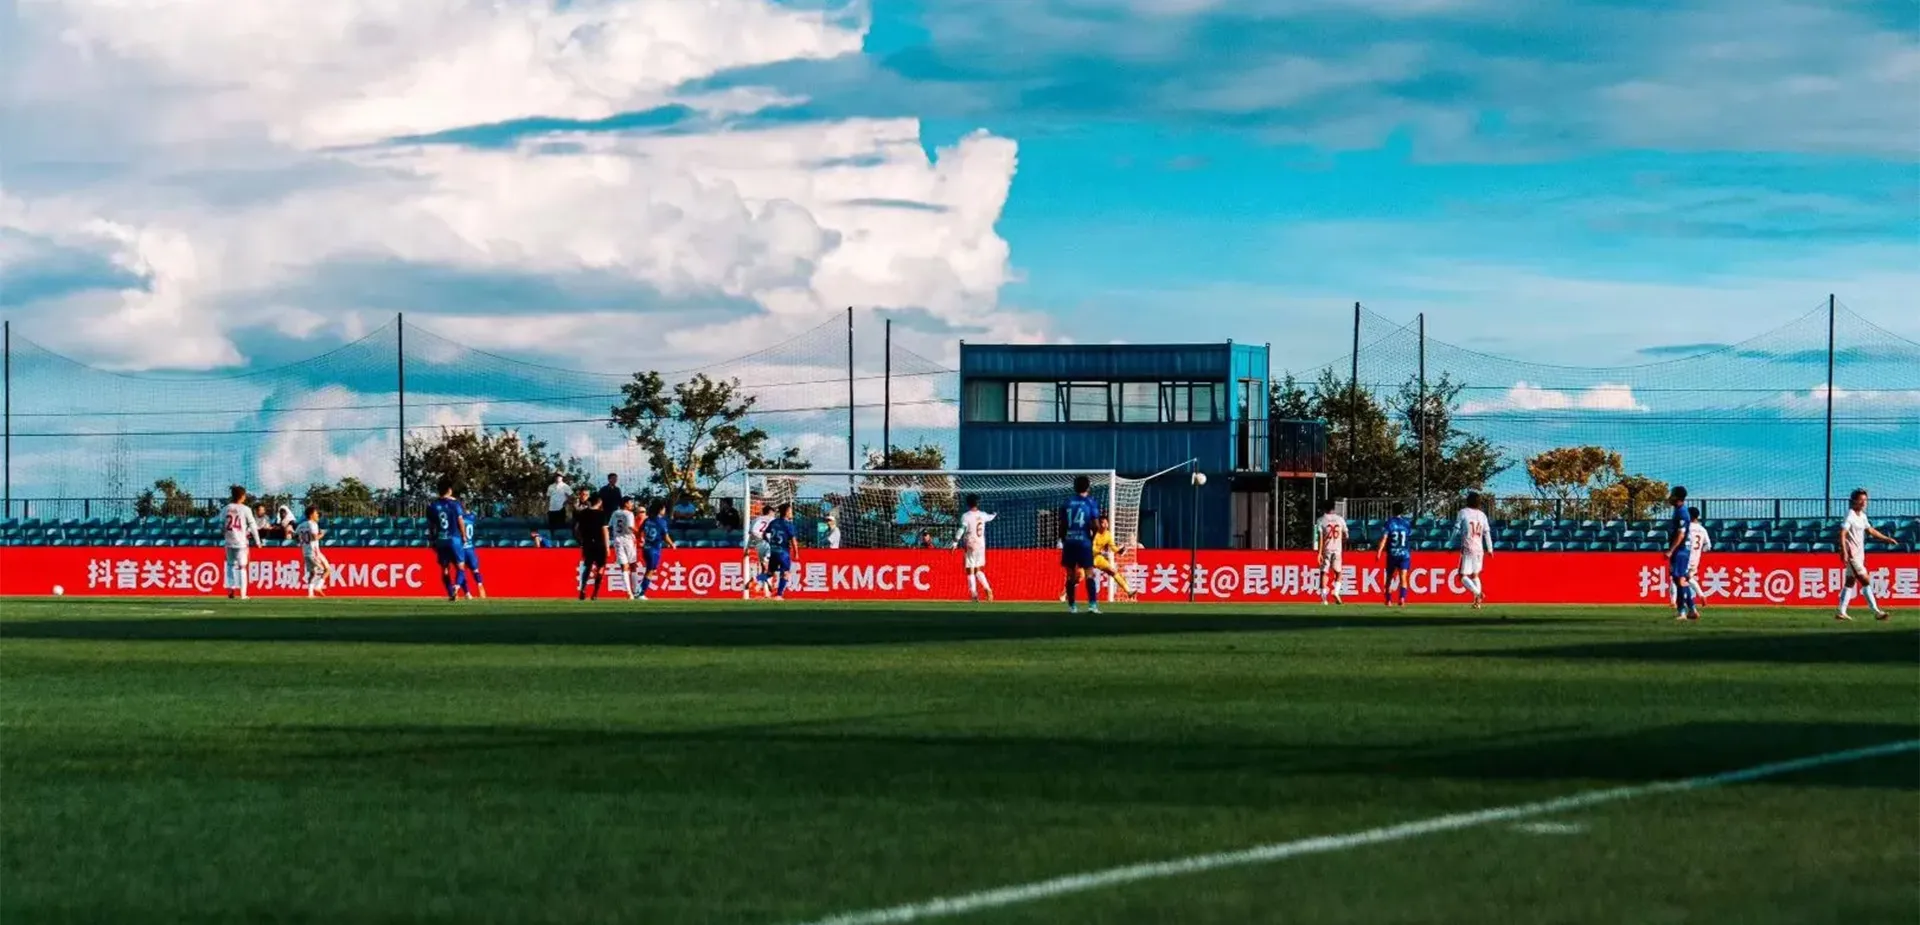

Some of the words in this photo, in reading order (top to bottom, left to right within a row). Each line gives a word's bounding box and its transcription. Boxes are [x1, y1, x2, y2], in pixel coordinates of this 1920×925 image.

[225, 515, 242, 533] 24
[439, 511, 449, 529] 8
[1066, 508, 1086, 528] 14
[1326, 523, 1340, 539] 26
[1391, 531, 1406, 547] 31
[1693, 535, 1702, 551] 3
[88, 559, 423, 592] 抖音关注@明城KMCFC
